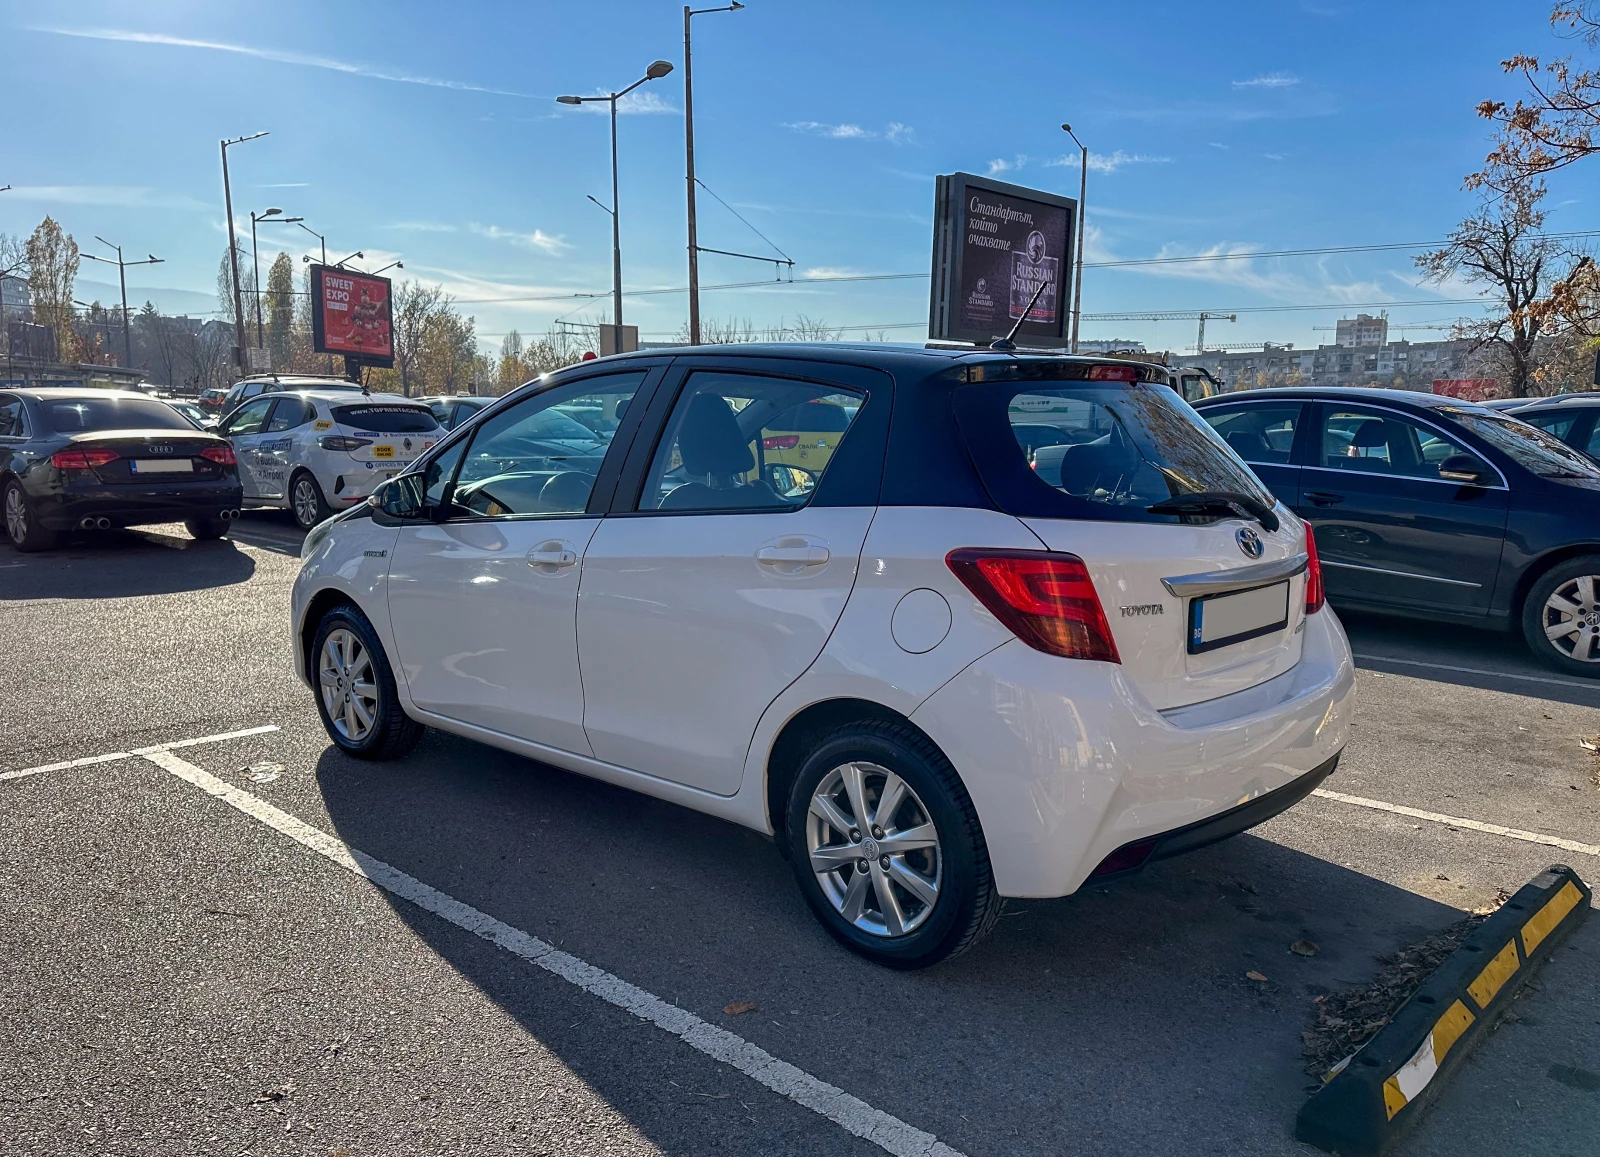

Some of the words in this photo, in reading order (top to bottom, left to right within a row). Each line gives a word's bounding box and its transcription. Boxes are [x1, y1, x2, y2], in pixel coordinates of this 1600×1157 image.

[970, 196, 1034, 227] Стандартът,
[969, 216, 998, 234] който
[968, 233, 1011, 251] очаквате
[1016, 261, 1053, 281] RUSSIAN
[326, 276, 353, 291] SWEET
[326, 289, 349, 302] EXPO
[968, 296, 994, 307] STANDARD
[1019, 295, 1046, 306] VOKA
[273, 442, 291, 450] OFFICE
[263, 470, 284, 481] Airport
[1119, 604, 1164, 617] TOYOTA
